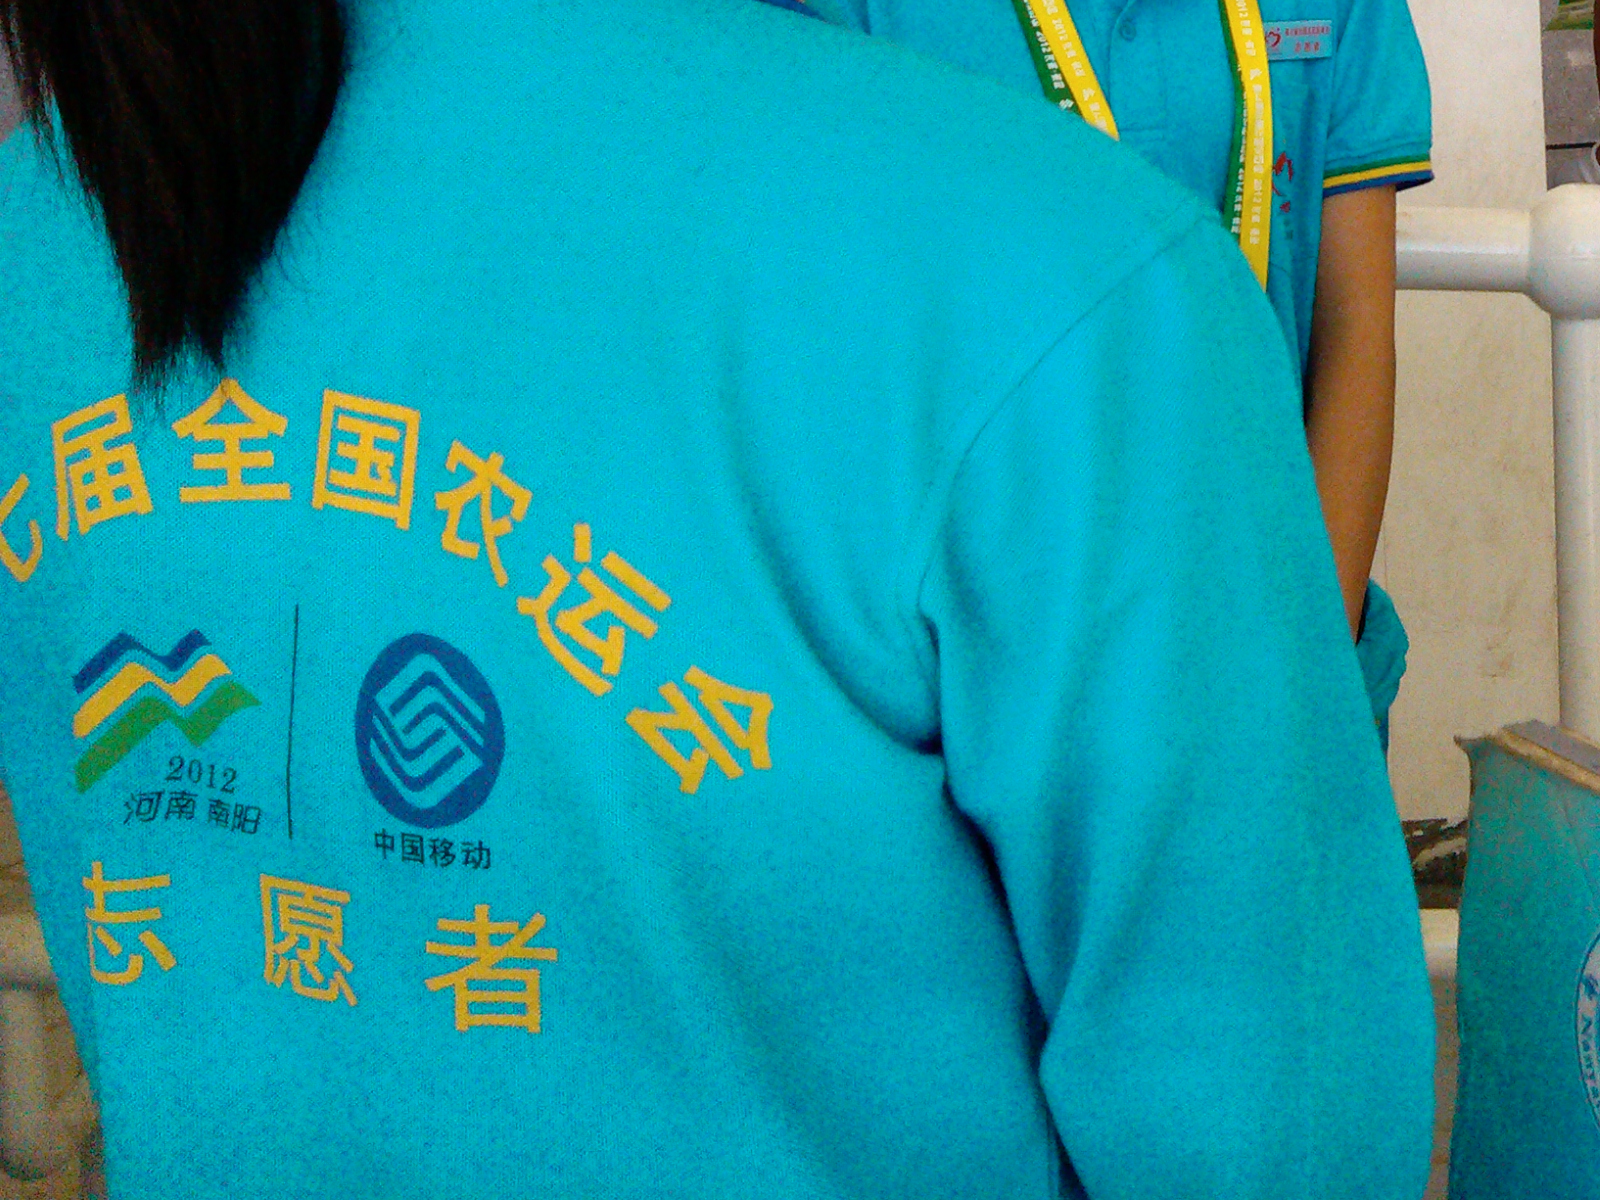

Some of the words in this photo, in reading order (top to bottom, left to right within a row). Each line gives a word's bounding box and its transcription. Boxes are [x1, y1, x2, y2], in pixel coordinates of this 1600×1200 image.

[165, 755, 237, 794] 2012
[123, 789, 197, 825] 河南
[207, 798, 263, 835] 南阳
[374, 828, 492, 870] 中国移动
[82, 860, 558, 1034] 志愿者
